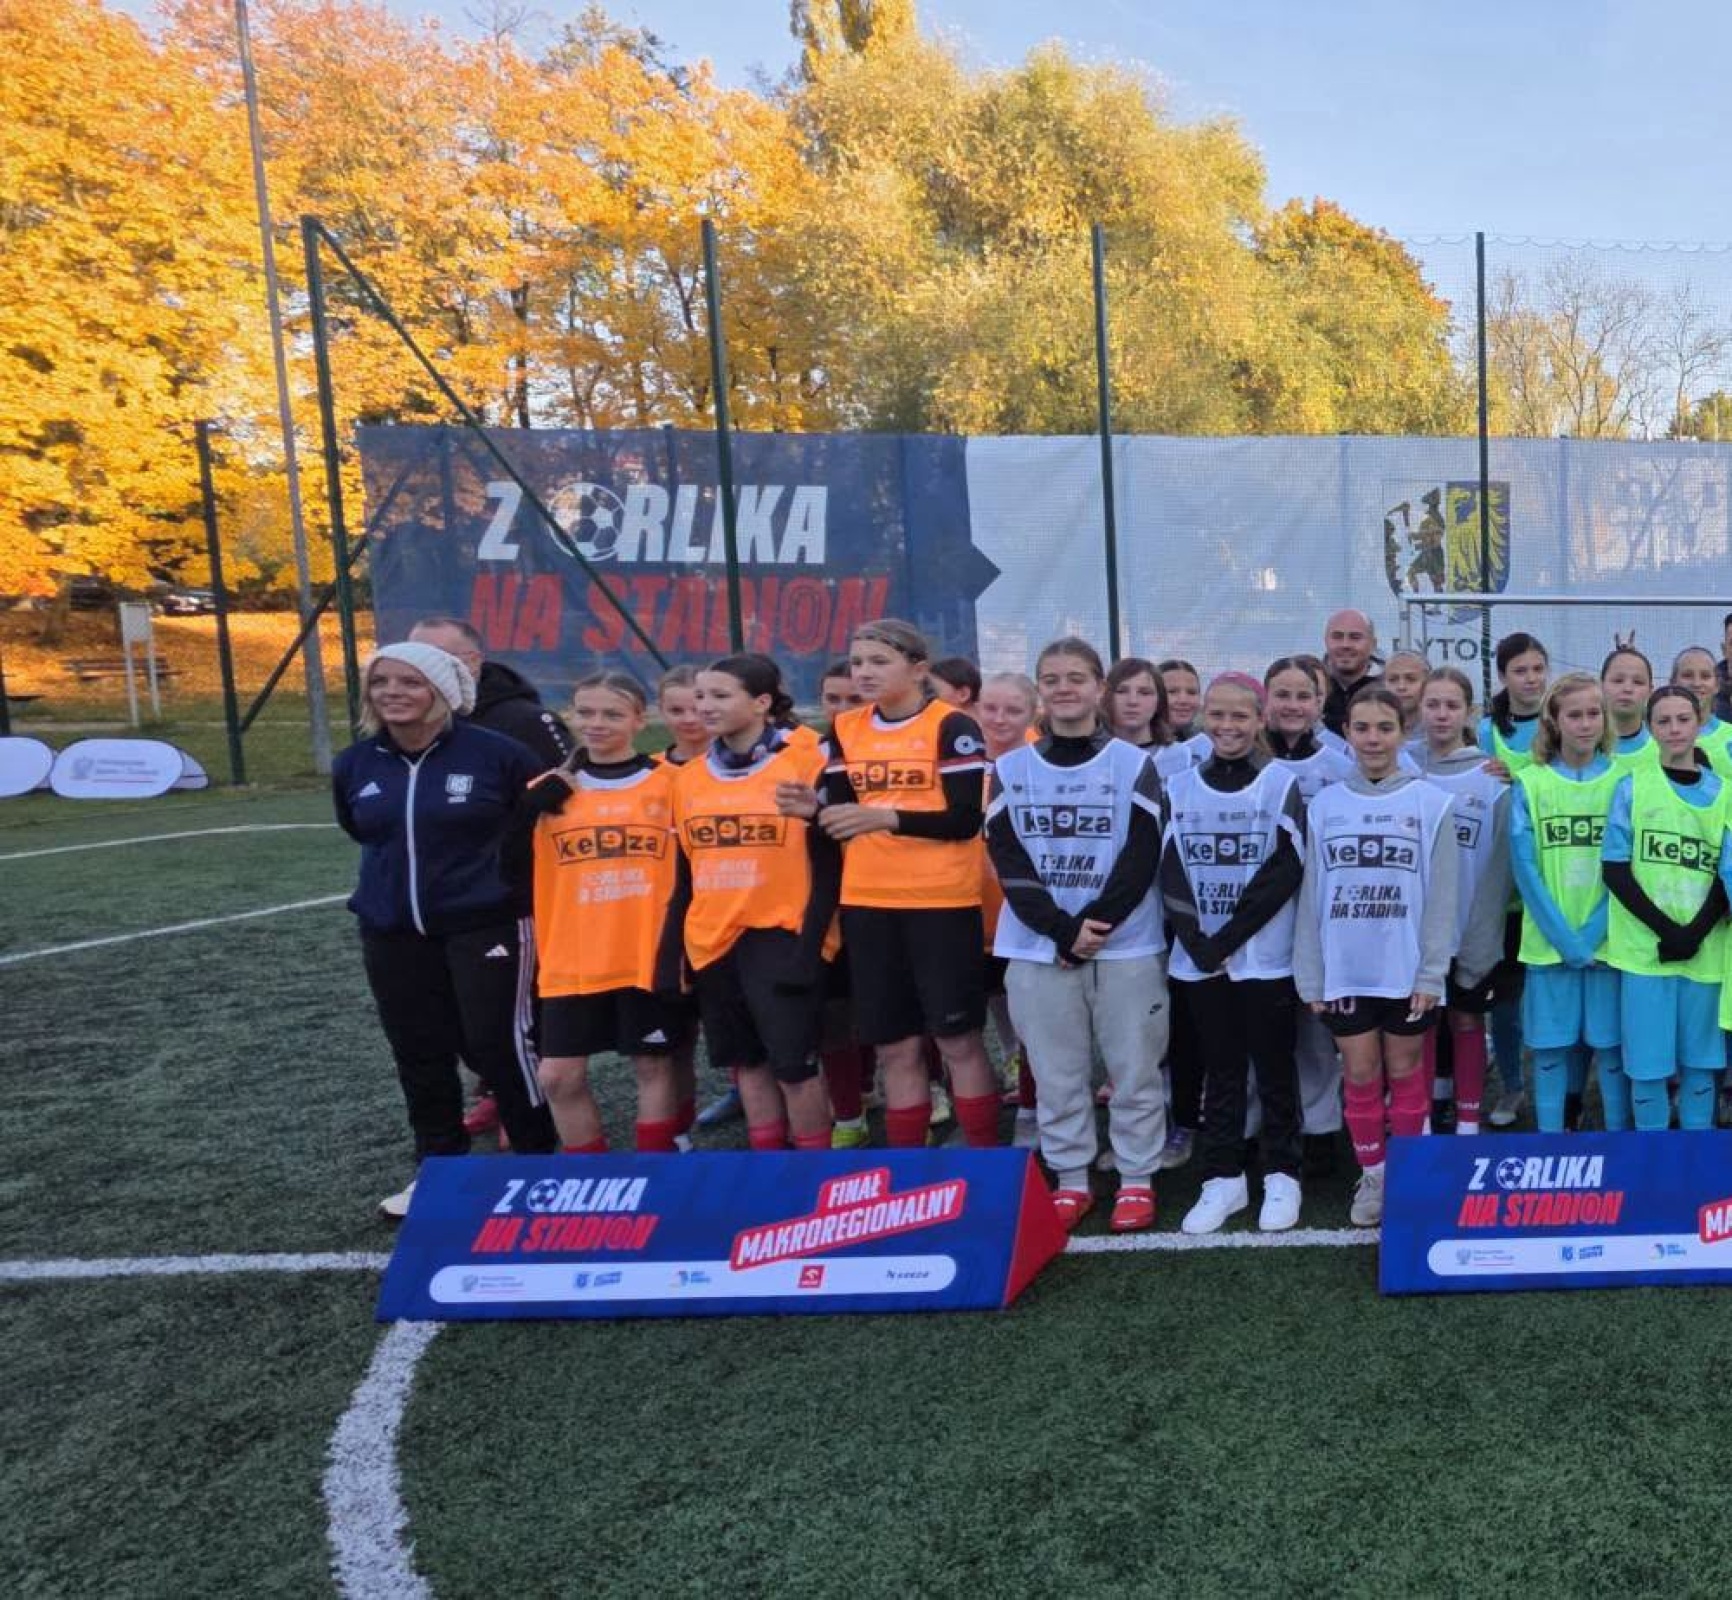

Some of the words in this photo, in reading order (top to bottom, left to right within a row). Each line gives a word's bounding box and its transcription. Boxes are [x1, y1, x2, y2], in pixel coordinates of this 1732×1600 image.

[478, 481, 522, 561] Z
[471, 573, 564, 653] NA
[1326, 839, 1414, 865] keeza
[827, 1172, 882, 1208] FINAŁ
[1468, 1158, 1490, 1190] Z
[492, 1179, 526, 1213] Z
[1457, 1194, 1499, 1227] NA
[1503, 1191, 1625, 1227] STADION
[471, 1217, 526, 1253] NA
[520, 1215, 660, 1252] STADION
[736, 1184, 960, 1265] MAKROREGIONALNY
